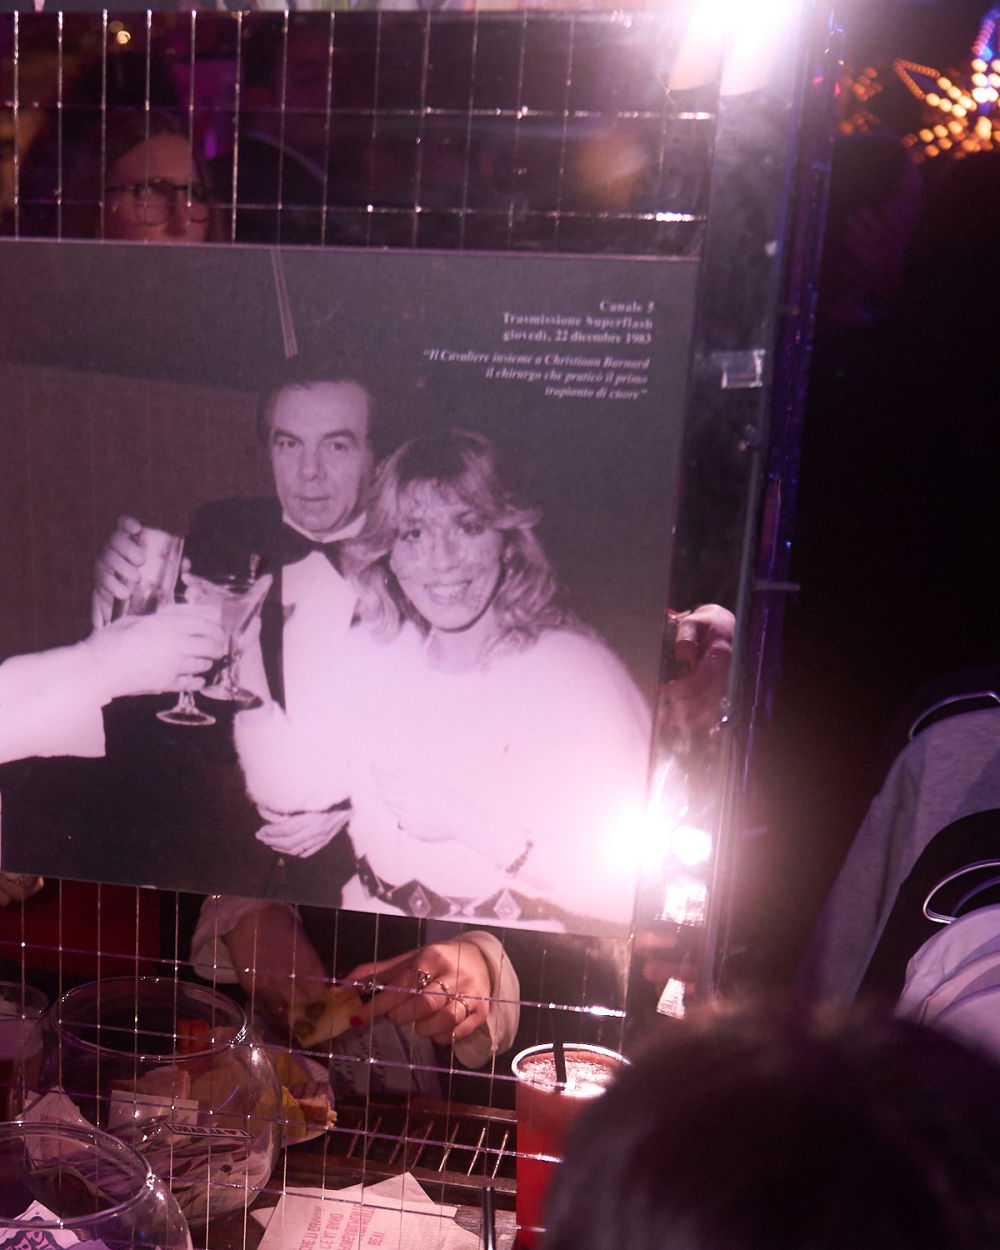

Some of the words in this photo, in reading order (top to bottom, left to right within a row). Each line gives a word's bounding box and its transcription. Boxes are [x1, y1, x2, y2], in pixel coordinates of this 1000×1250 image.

[599, 300, 642, 313] Canale
[503, 312, 582, 326] Trasmissione
[585, 315, 653, 330] Superflash
[555, 330, 569, 342] 22
[570, 330, 621, 343] dicembre
[440, 350, 490, 363] Cavaliere
[492, 353, 533, 364] insieme
[535, 357, 543, 365] a
[603, 356, 650, 370] Barnard
[485, 367, 495, 378] il
[495, 367, 542, 381] chirurgo
[543, 368, 562, 381] che
[604, 371, 613, 383] il
[614, 371, 648, 386] primo
[545, 385, 595, 399] trapianto
[596, 387, 607, 398] di
